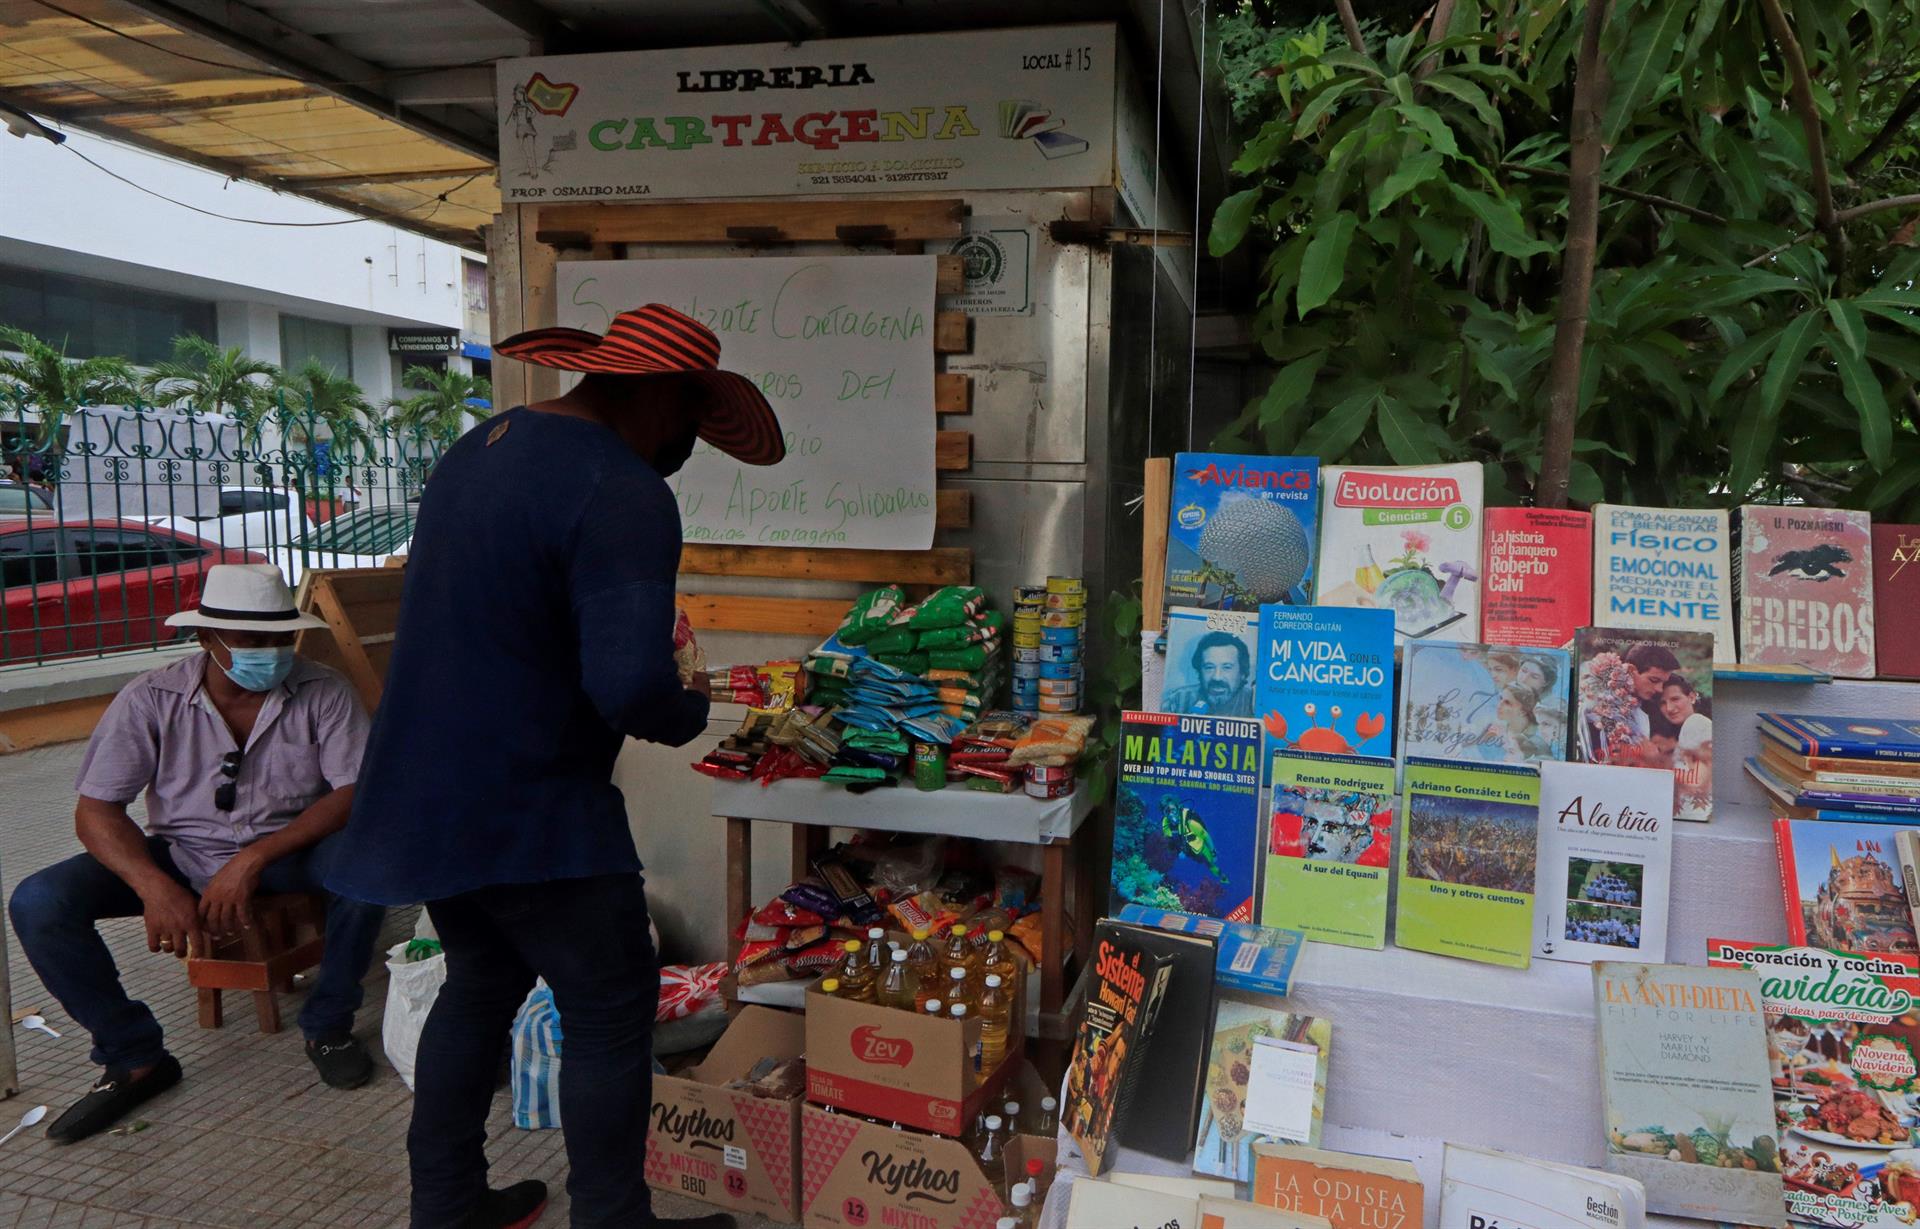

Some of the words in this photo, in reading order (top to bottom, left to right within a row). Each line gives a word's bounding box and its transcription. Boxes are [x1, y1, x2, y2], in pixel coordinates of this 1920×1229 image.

[1022, 54, 1061, 70] LOCAL
[1078, 47, 1091, 71] 15
[677, 63, 875, 92] LIBRERIA
[588, 105, 980, 150] CARTAGENA
[883, 158, 964, 172] DOMICILIO
[552, 185, 613, 196] OSMAIRO
[615, 184, 651, 195] MAZA
[1200, 463, 1311, 490] Avianca
[1262, 490, 1273, 500] en
[1276, 490, 1309, 501] revista
[1342, 479, 1454, 503] Evolución
[1378, 512, 1428, 522] Ciencias
[1454, 510, 1463, 525] 6
[1610, 518, 1628, 528] EL
[1632, 520, 1718, 533] BIENESTAR
[1655, 513, 1718, 524] ALCANZAR
[1491, 530, 1504, 543] La
[1505, 530, 1544, 544] historia
[1610, 529, 1718, 553] FÍSICO
[1491, 542, 1506, 555] del
[1508, 543, 1557, 558] banquero
[1490, 556, 1548, 575] Roberto
[1610, 556, 1719, 580] EMOCIONAL
[1488, 573, 1524, 592] Calvi
[1610, 574, 1696, 590] MEDIANTE
[1700, 582, 1718, 592] EL
[1610, 584, 1666, 597] PODER
[1670, 589, 1693, 599] DE
[1697, 592, 1719, 601] LA
[1273, 611, 1313, 622] FERNANDO
[1610, 595, 1721, 620] MENTE
[1273, 620, 1314, 631] CORREDOR
[1315, 621, 1342, 632] GAITÁN
[1271, 639, 1292, 661] MI
[1297, 639, 1347, 661] VIDA
[1350, 652, 1369, 664] CON
[1371, 654, 1382, 665] EL
[1269, 661, 1384, 687] CANGREJO
[1181, 718, 1211, 734] DIVE
[1215, 720, 1258, 739] GUIDE
[1125, 734, 1257, 772] MALAYSIA
[1123, 763, 1141, 773] OVER
[1143, 765, 1154, 774] 110
[1156, 767, 1169, 775] TOP
[1171, 768, 1187, 777] DIVE
[1189, 770, 1203, 779] AND
[1204, 770, 1235, 782] SNORKEL
[1236, 774, 1256, 784] SITES
[1296, 773, 1331, 784] Renato
[1122, 774, 1155, 784] INCLUDING
[1208, 782, 1221, 791] AND
[1222, 783, 1255, 795] SINGAPORE
[1411, 780, 1452, 792] Adriano
[1454, 784, 1502, 798] González
[1505, 789, 1531, 800] León
[1558, 796, 1584, 826] A
[1588, 802, 1612, 828] la
[1616, 806, 1660, 832] tiña
[1302, 864, 1312, 872] Al
[1330, 867, 1344, 875] del
[1346, 869, 1379, 880] Equanil
[1430, 884, 1448, 894] Uno
[1451, 888, 1457, 897] y
[1460, 889, 1484, 900] otros
[1487, 894, 1525, 905] cuentos
[1722, 947, 1823, 969] Decoración
[1827, 958, 1838, 971] y
[1844, 959, 1905, 975] cocina
[1096, 941, 1145, 1005] Sistema
[1099, 979, 1127, 1015] Howard
[1605, 979, 1632, 1004] LA
[1761, 968, 1911, 1015] avideña
[1608, 1006, 1638, 1018] FIT
[1656, 1009, 1694, 1023] FOR
[1710, 1014, 1757, 1027] LIFE
[1786, 1005, 1815, 1017] ideas
[1818, 1010, 1846, 1021] para
[1848, 1010, 1893, 1024] decorar
[864, 1037, 900, 1058] Zev
[1659, 1033, 1694, 1044] HARVEY
[1703, 1036, 1709, 1044] Y
[1661, 1042, 1710, 1054] MARILYN
[1661, 1051, 1711, 1063] DIAMOND
[1856, 1047, 1908, 1062] Novena
[1852, 1058, 1914, 1075] Navideña
[810, 1083, 845, 1101] TOMATE
[652, 1102, 735, 1143] Kythos
[670, 1153, 718, 1180] MIXTOS
[861, 1150, 960, 1195] Kythos
[681, 1174, 707, 1196] BBQ
[729, 1175, 744, 1191] 12
[1274, 1172, 1300, 1193] LA
[1313, 1178, 1406, 1212] ODISEA
[847, 1201, 865, 1219] 12
[1274, 1192, 1304, 1213] DE
[1319, 1199, 1345, 1221] LA
[1361, 1206, 1406, 1229] LUZ
[1586, 1196, 1619, 1219] Gestión
[1792, 1202, 1827, 1218] Arroz
[1838, 1208, 1879, 1224] Postres
[1827, 1194, 1868, 1210] Carnes
[1880, 1204, 1908, 1217] Aves
[882, 1205, 939, 1229] MIXTOS
